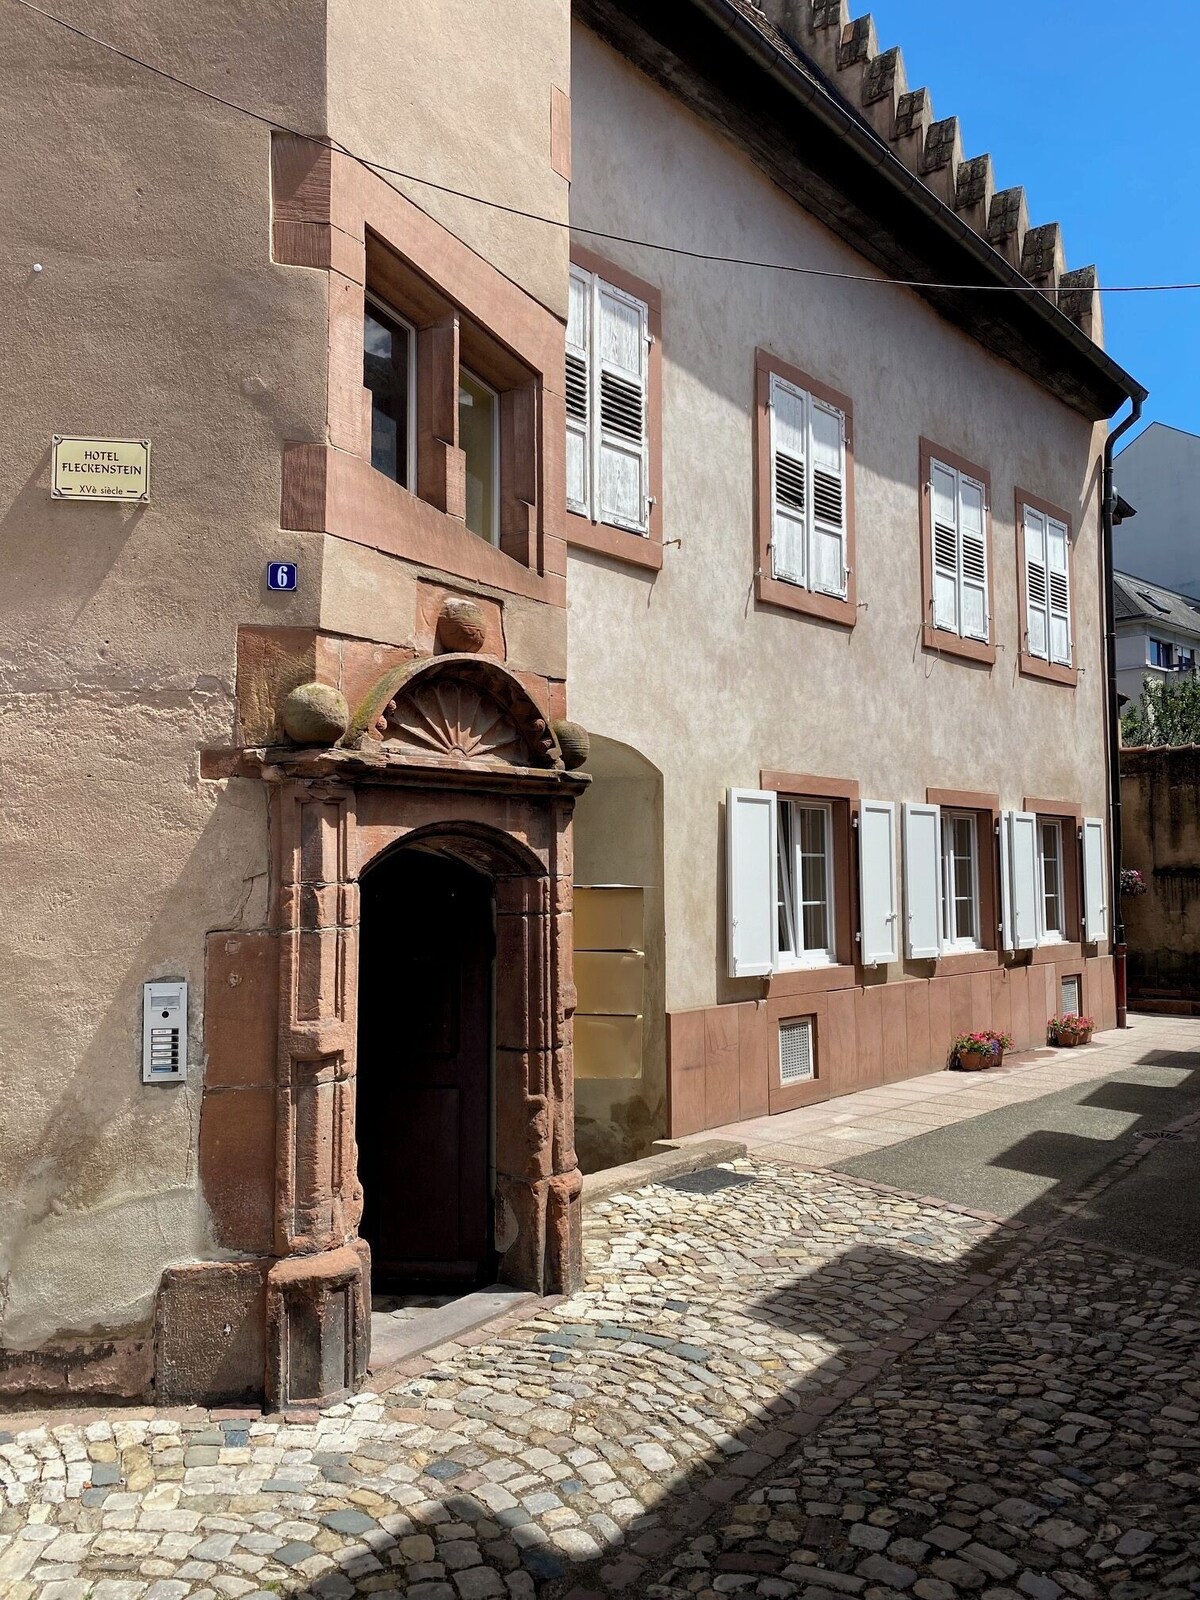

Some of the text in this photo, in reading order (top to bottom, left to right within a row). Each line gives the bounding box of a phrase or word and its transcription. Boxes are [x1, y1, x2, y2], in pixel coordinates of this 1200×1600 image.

[84, 451, 119, 461] HOTEL
[62, 463, 142, 475] FLECKENSTEIN
[79, 485, 123, 495] XVè siècle
[277, 565, 288, 587] 6
